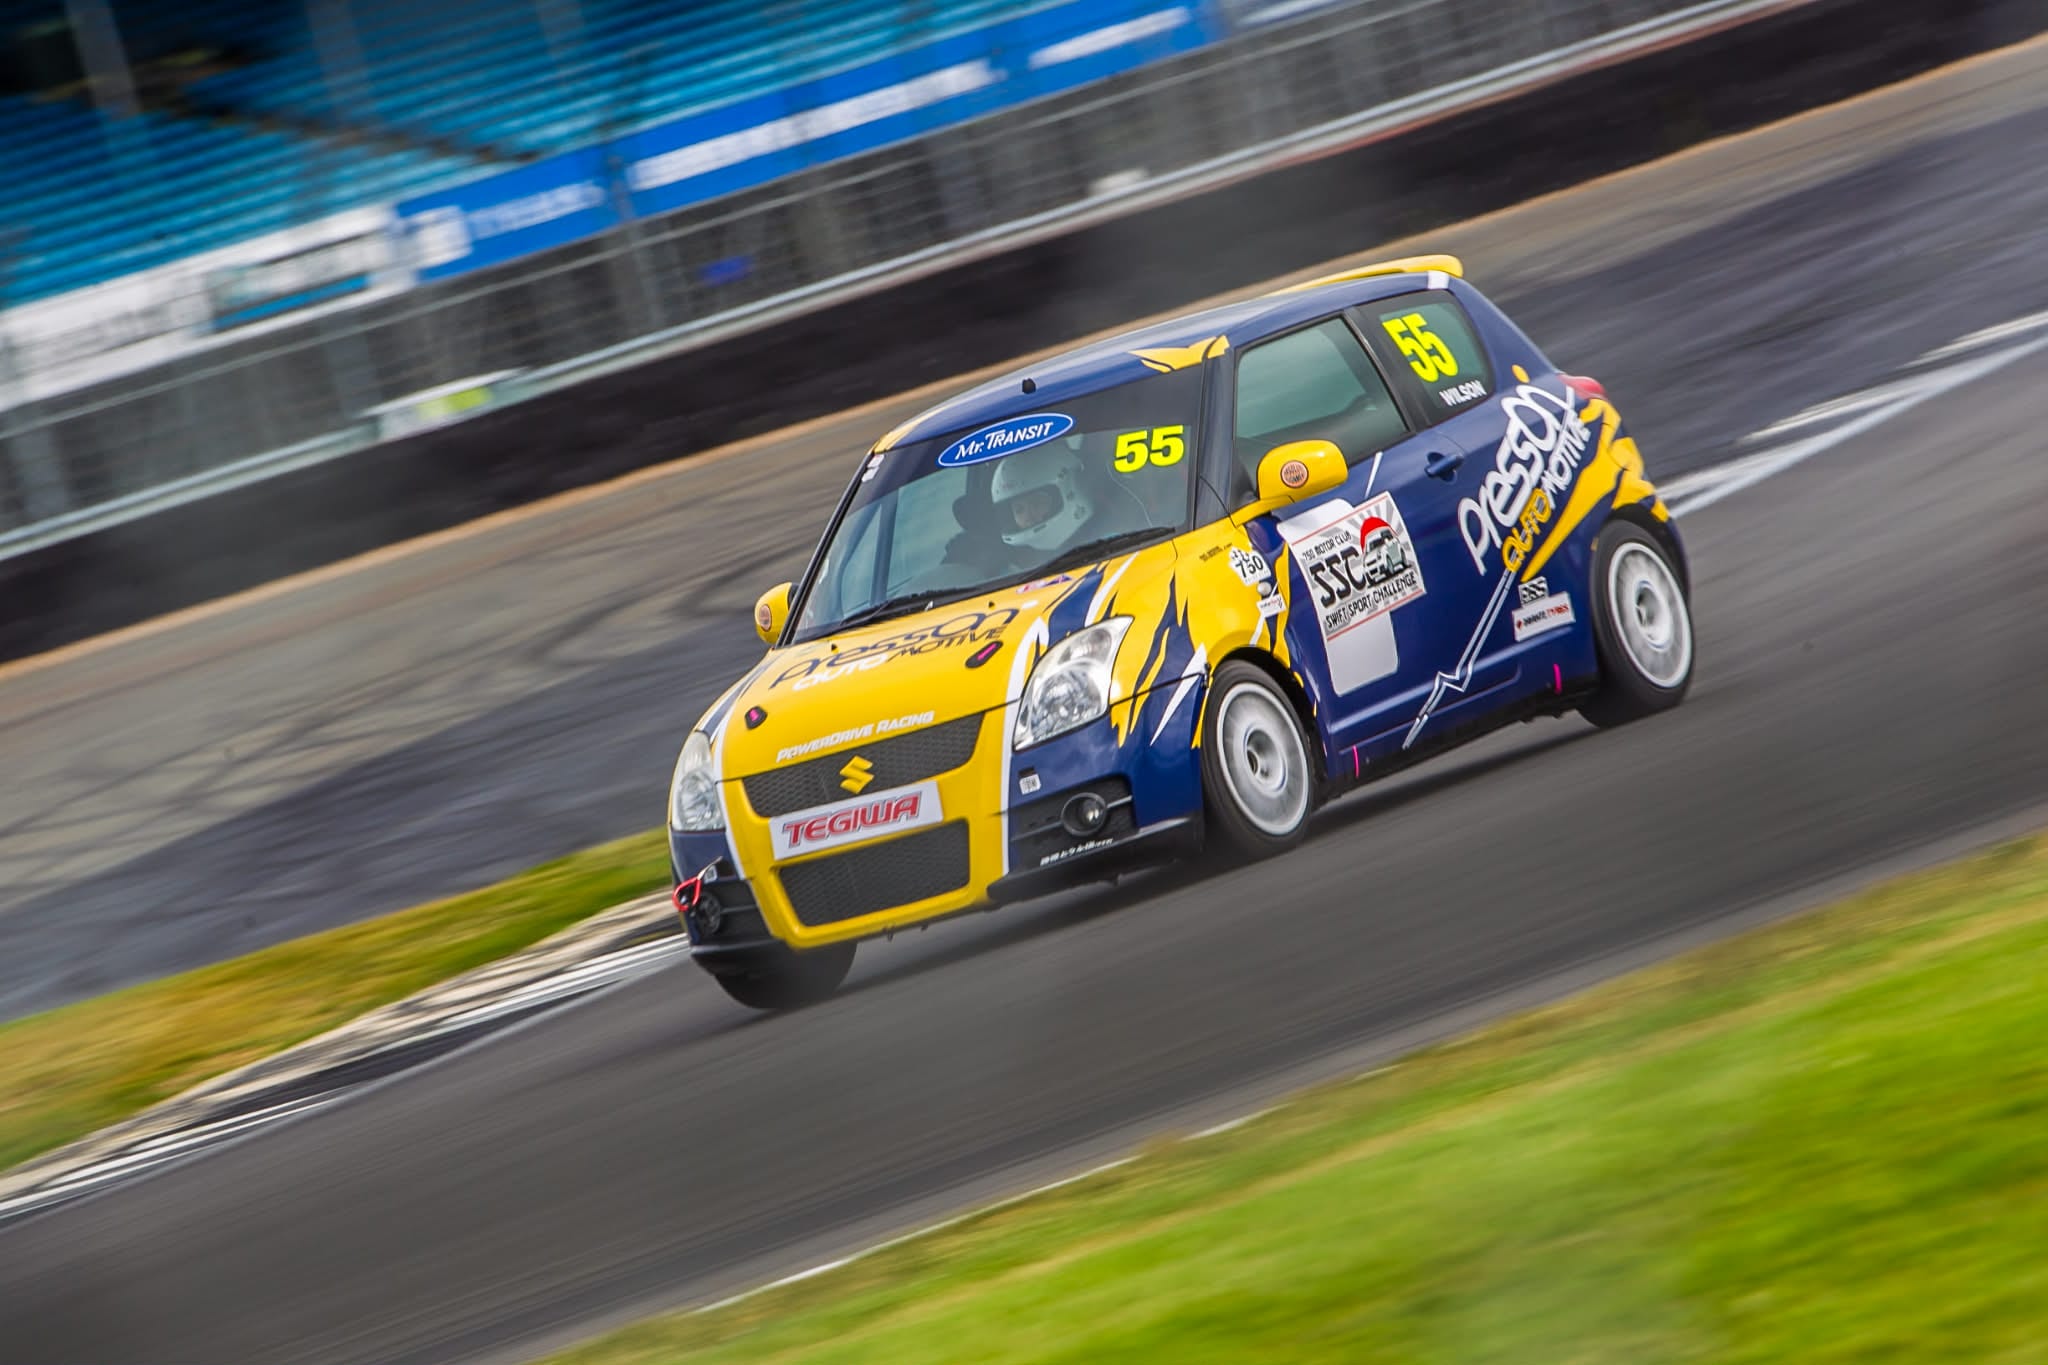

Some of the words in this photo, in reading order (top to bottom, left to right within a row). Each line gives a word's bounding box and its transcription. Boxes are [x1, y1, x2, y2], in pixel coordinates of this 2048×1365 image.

[1382, 313, 1458, 382] 55
[1439, 380, 1488, 406] WILSON
[954, 442, 983, 460] Mr.
[985, 422, 1053, 450] TRANSIT
[1114, 425, 1184, 473] 55
[1235, 555, 1264, 579] 750
[1316, 540, 1335, 556] MOTOR
[1309, 546, 1368, 608] SSC
[1326, 607, 1348, 629] SWIFT
[1349, 595, 1372, 617] SPORT
[1373, 571, 1417, 604] CHALLENGE
[776, 723, 874, 763] POWERDRIVE
[876, 710, 935, 735] RACING
[782, 791, 923, 849] TEGIWA
